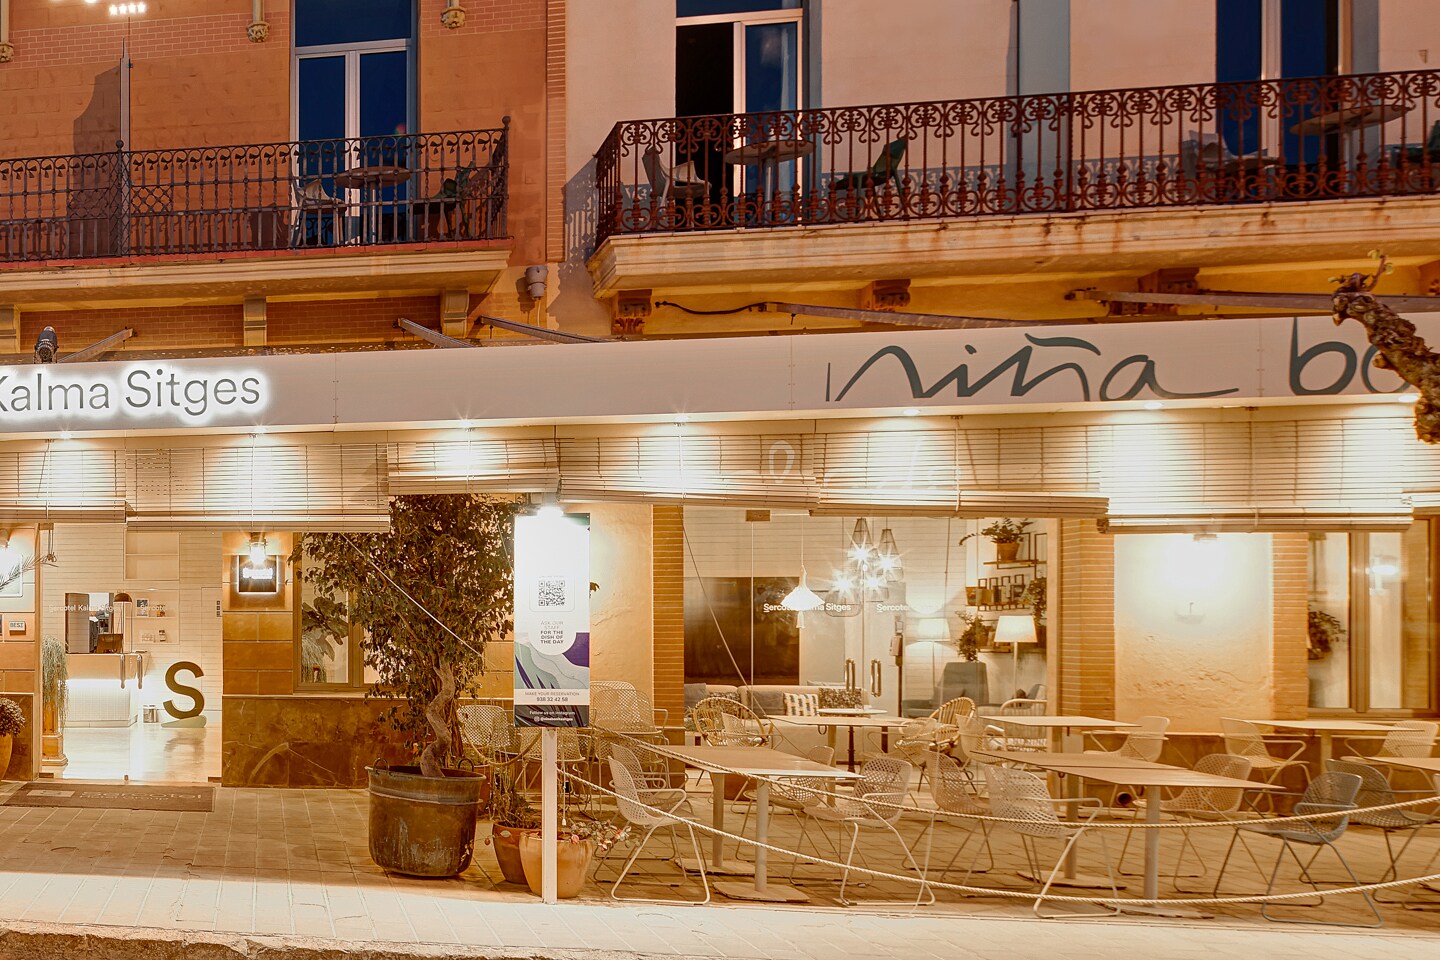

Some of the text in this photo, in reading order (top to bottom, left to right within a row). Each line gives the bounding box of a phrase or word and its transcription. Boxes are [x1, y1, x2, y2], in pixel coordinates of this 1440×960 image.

[125, 368, 261, 417] Sitges
[825, 602, 852, 613] Sitges
[163, 661, 205, 719] S
